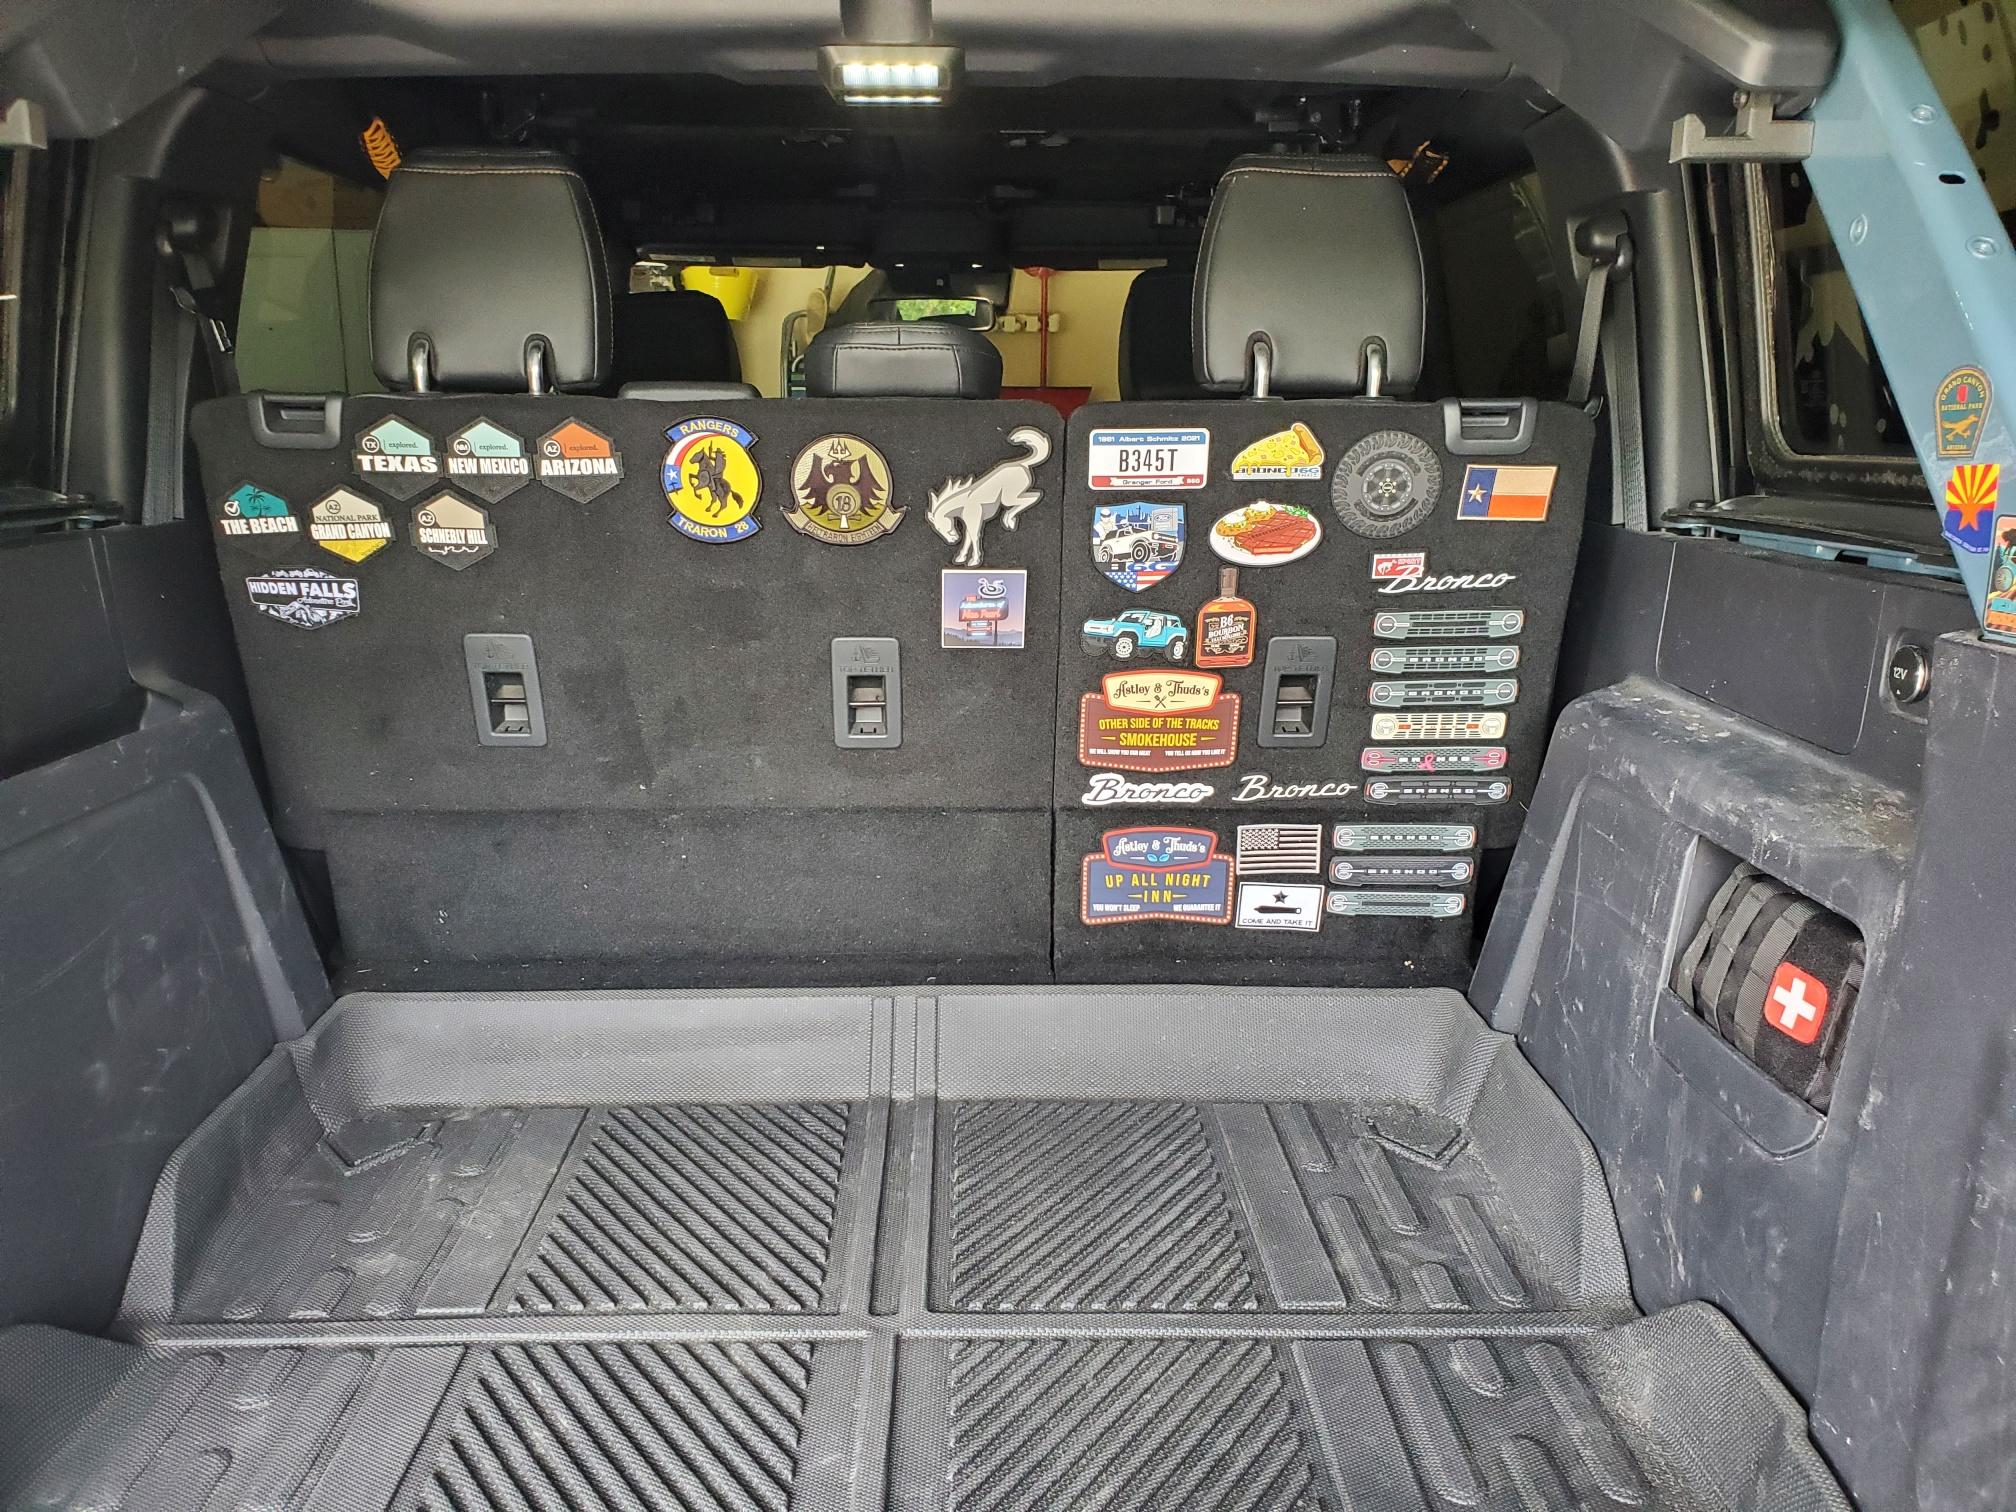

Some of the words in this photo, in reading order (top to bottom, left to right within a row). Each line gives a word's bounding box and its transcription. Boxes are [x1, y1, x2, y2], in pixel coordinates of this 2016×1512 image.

[680, 420, 740, 438] RANGERS
[364, 440, 377, 449] TX
[388, 442, 419, 450] explored.
[546, 444, 559, 454] AZ
[357, 455, 438, 473] TEXAS
[448, 457, 478, 475] NEW
[480, 457, 529, 475] MEXICO
[540, 458, 618, 475] ARIZONA
[1119, 448, 1178, 472] B345T
[328, 503, 340, 511] AZ
[835, 495, 852, 512] 18
[221, 519, 251, 535] THE
[250, 516, 299, 534] BEACH
[316, 514, 356, 522] NATIONAL
[357, 513, 379, 521] PARK
[420, 515, 433, 523] AZ
[310, 523, 347, 540] GRAND
[347, 522, 392, 539] CANYON
[677, 517, 728, 538] TRARON
[735, 520, 750, 533] 28
[419, 528, 466, 544] SCHNEBLY
[467, 529, 488, 545] HILL
[1378, 564, 1517, 594] Bronco
[249, 581, 299, 596] HIDDEN
[299, 582, 357, 599] FALLS
[1219, 613, 1234, 629] B6
[1208, 622, 1246, 639] BOURBON
[1893, 666, 1909, 680] 12V
[1113, 680, 1150, 699] Astley
[1166, 680, 1210, 697] Thuds's
[1098, 718, 1129, 731] OTHER
[1130, 718, 1151, 729] SIDE
[1152, 717, 1164, 729] OF
[1165, 717, 1183, 729] THE
[1185, 718, 1220, 731] TRACKS
[1119, 732, 1198, 747] SMOKEHOUSE
[1398, 755, 1471, 764] BRNCO
[1085, 775, 1211, 803] Bronco
[1231, 775, 1358, 802] Bronco
[1113, 837, 1149, 857] Astley
[1151, 839, 1161, 851] &
[1163, 836, 1207, 854] Thuds's
[1105, 874, 1124, 888] UP
[1131, 873, 1158, 887] ALL
[1165, 873, 1212, 888] NIGHT
[1143, 890, 1172, 903] INN
[1092, 903, 1104, 912] YOU
[1215, 903, 1222, 911] IT
